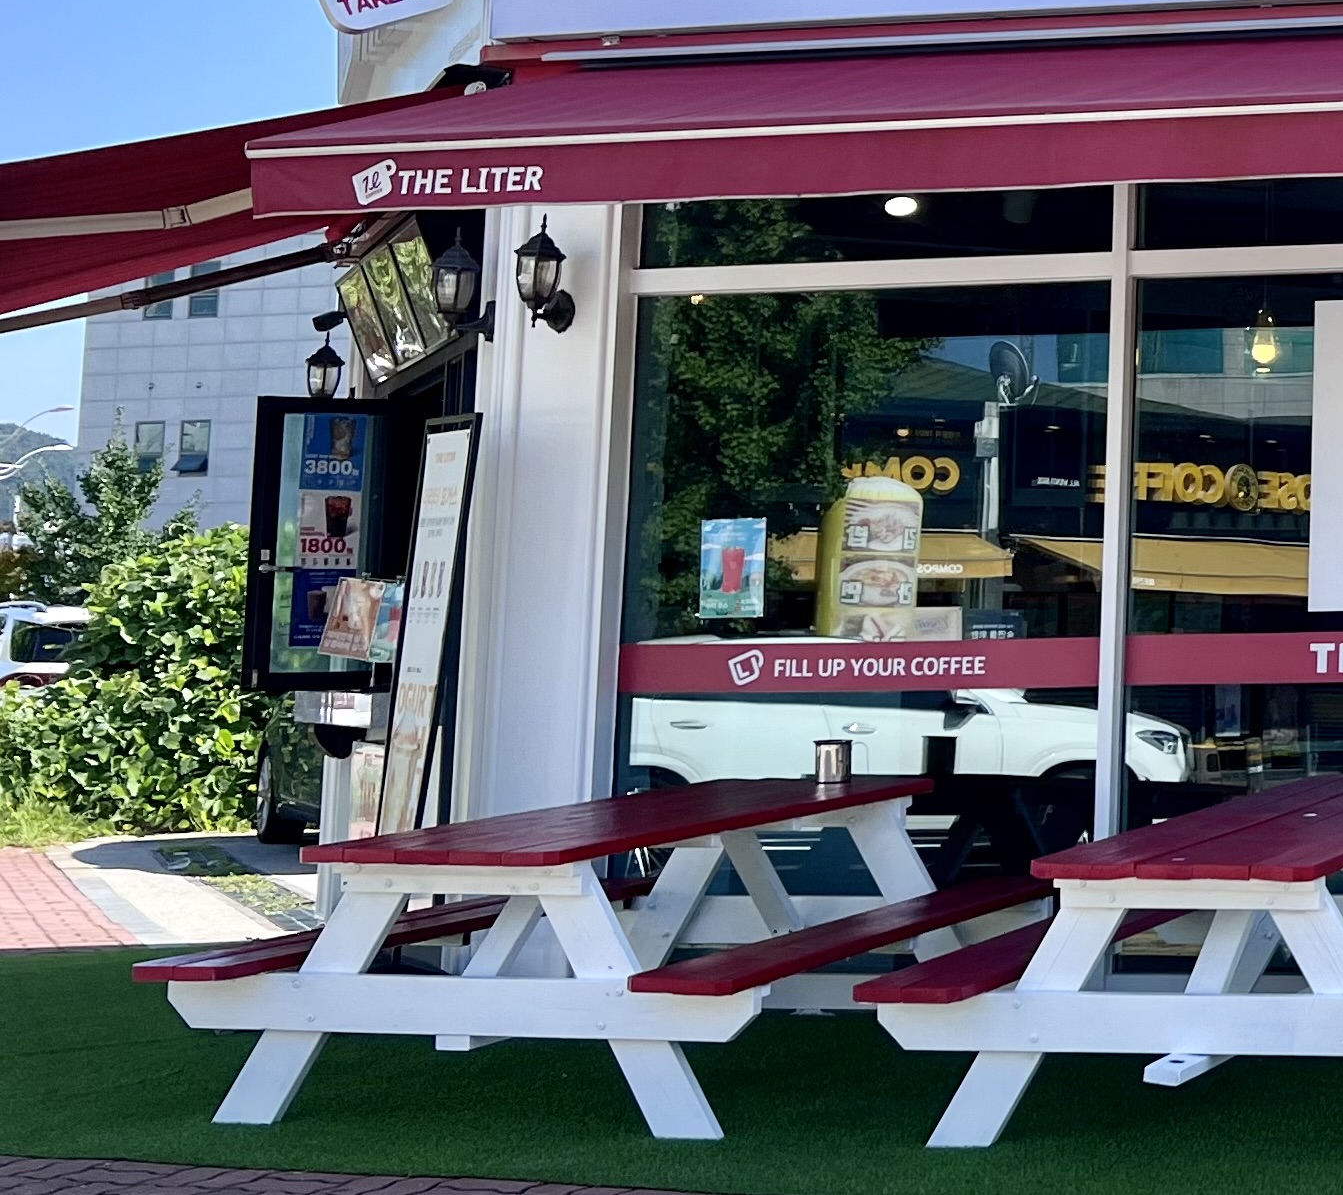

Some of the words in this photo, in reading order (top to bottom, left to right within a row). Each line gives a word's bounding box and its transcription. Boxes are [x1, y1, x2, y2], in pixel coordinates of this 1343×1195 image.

[398, 169, 453, 195] THE
[460, 166, 544, 193] LITER
[774, 659, 813, 677] FILL
[818, 658, 846, 676] UP
[851, 657, 906, 676] YOUR
[911, 656, 986, 676] COFFEE
